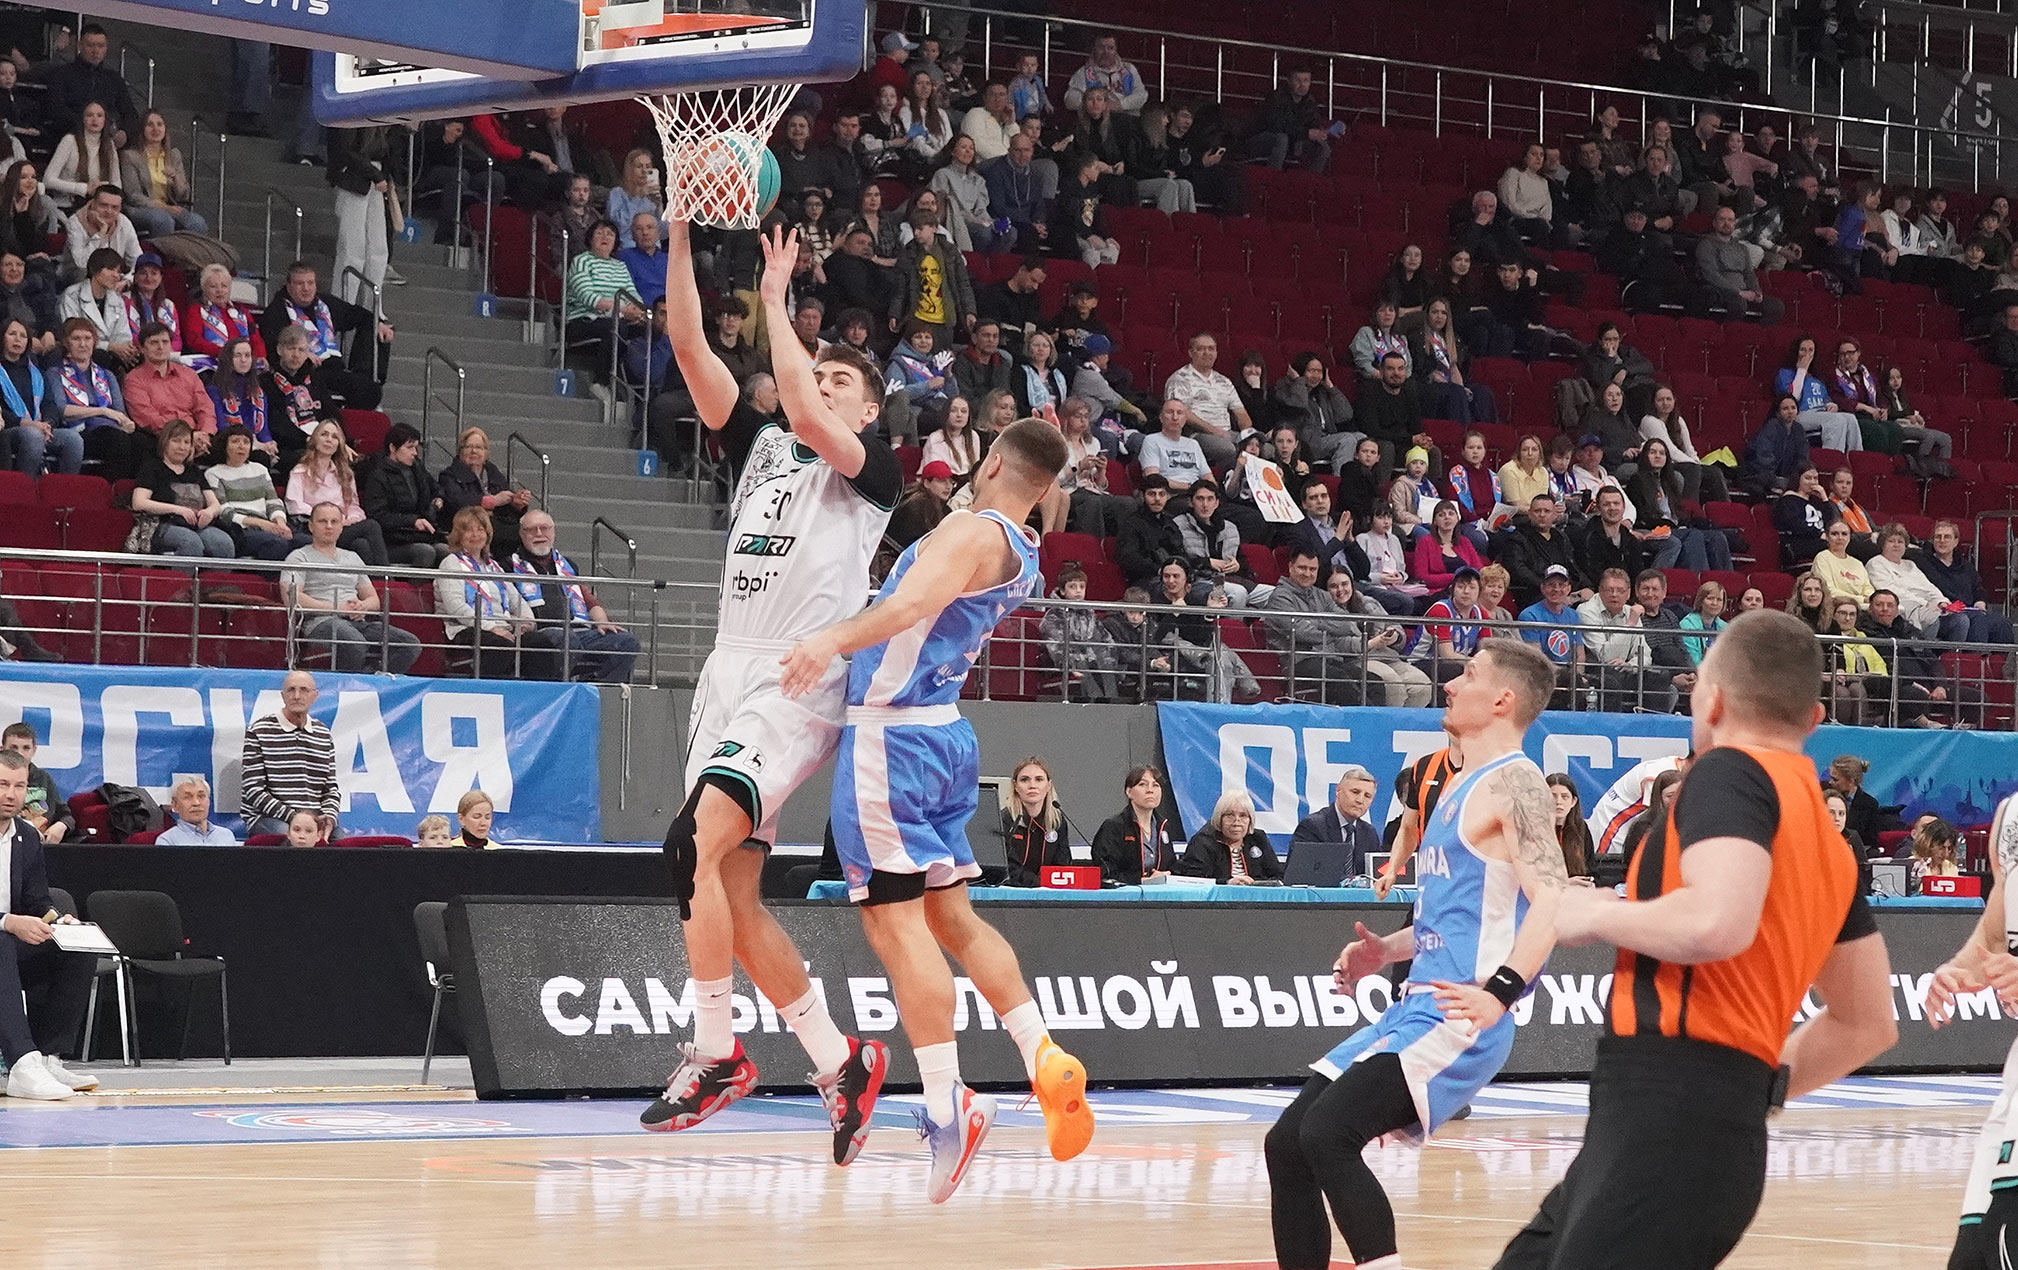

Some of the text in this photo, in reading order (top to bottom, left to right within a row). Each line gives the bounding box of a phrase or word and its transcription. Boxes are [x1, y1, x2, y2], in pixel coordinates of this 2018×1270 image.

[1975, 81, 1992, 129] 5
[407, 226, 415, 243] 9
[482, 300, 491, 317] 8
[560, 378, 568, 395] 7
[643, 458, 651, 475] 6
[1051, 871, 1075, 886] 5
[1930, 880, 1956, 893] 5
[847, 960, 1200, 1032] БЛШОЙ
